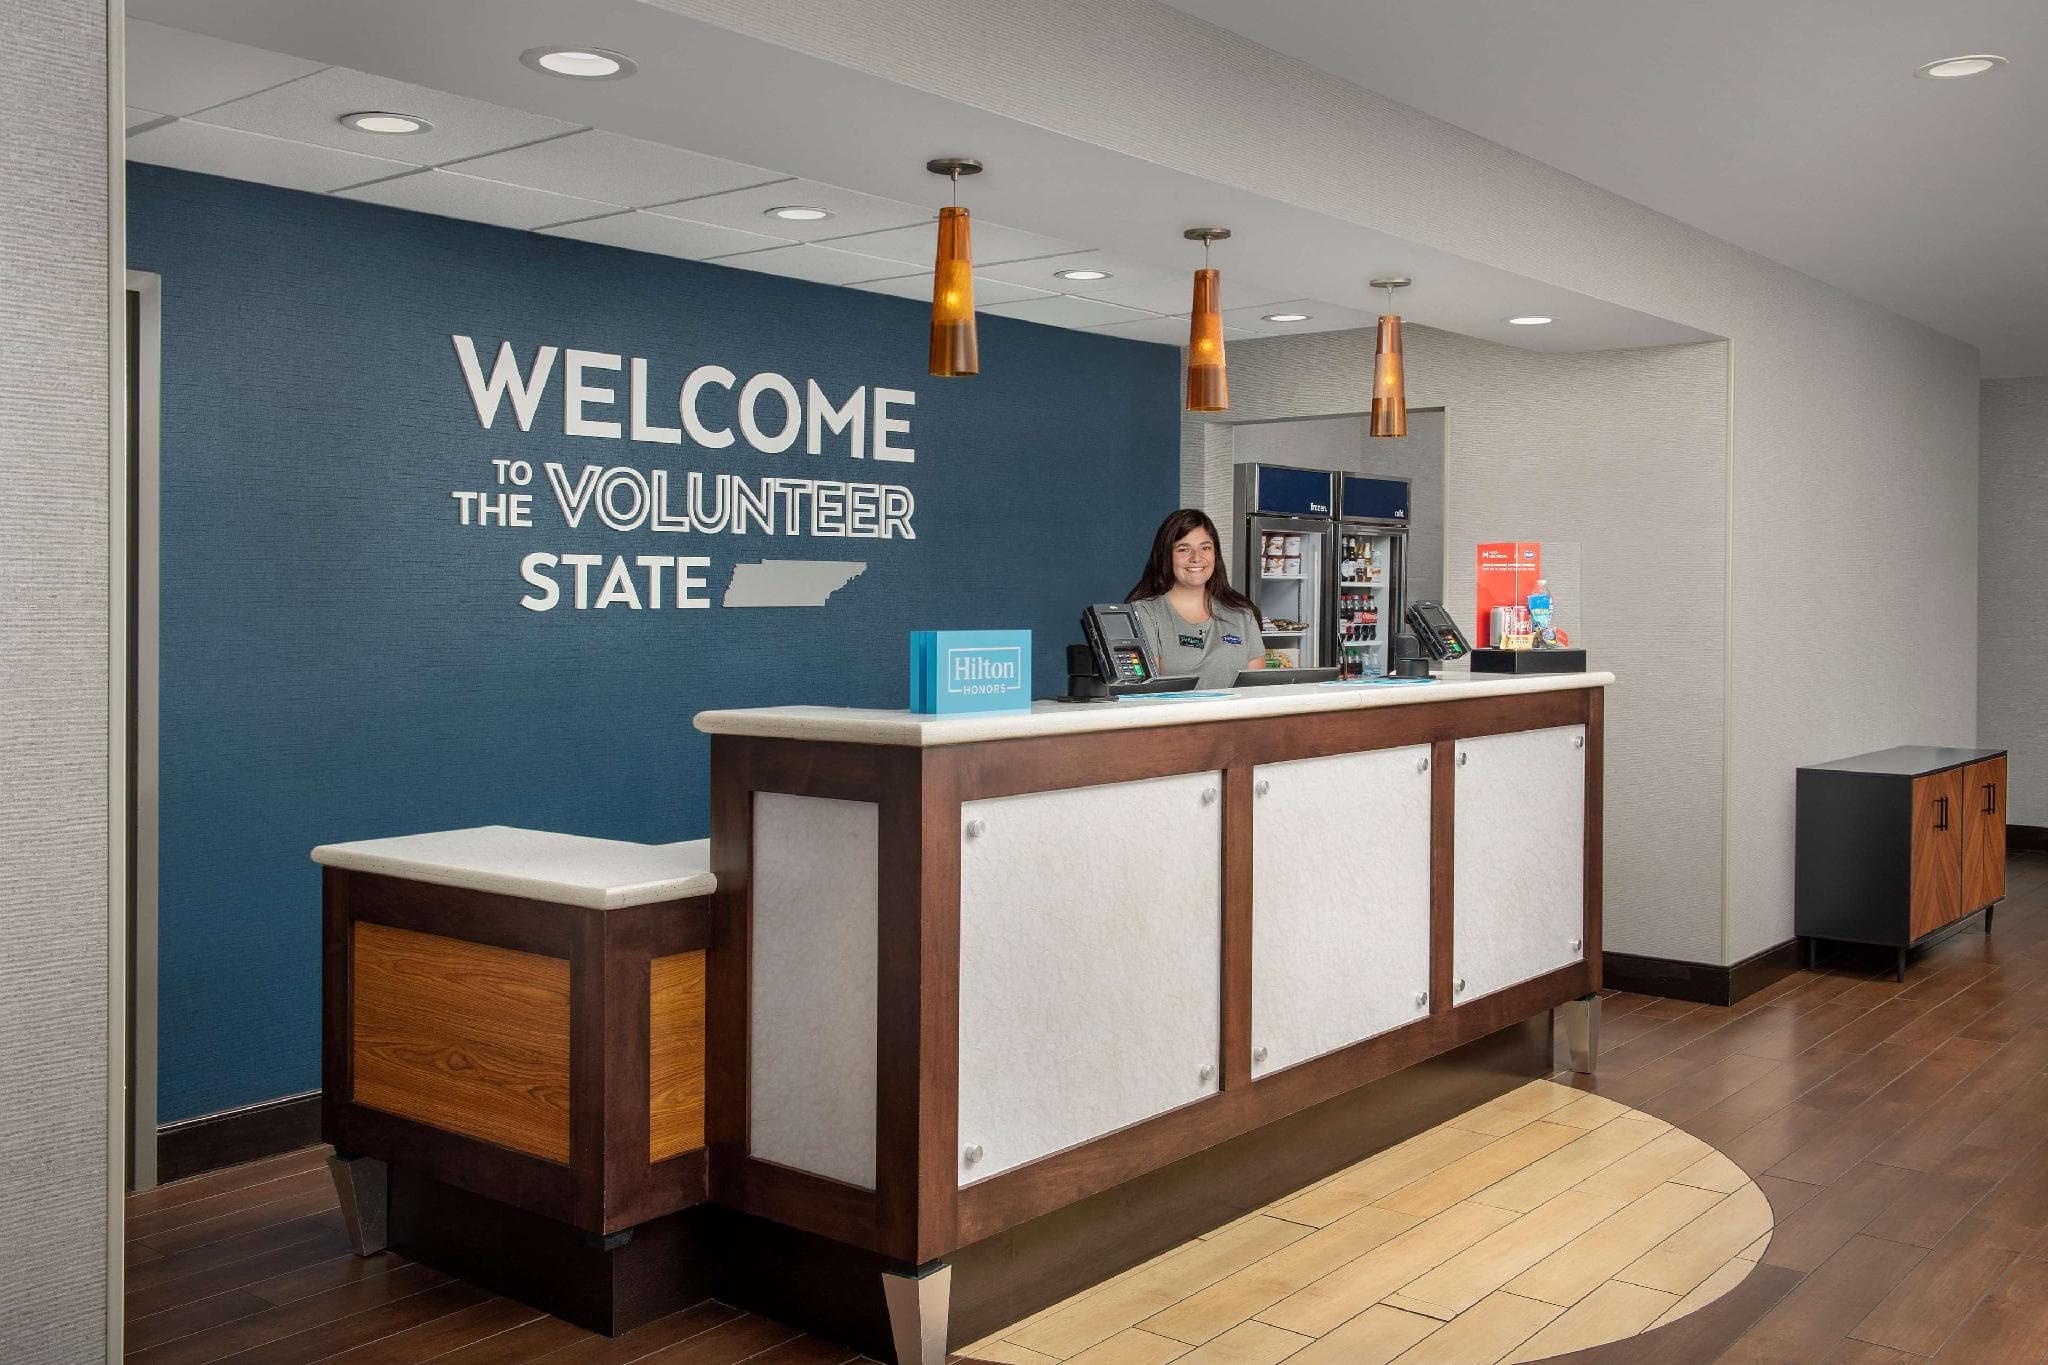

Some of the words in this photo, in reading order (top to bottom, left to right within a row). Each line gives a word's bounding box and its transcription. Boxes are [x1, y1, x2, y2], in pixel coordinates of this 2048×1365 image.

[452, 335, 916, 462] WELCOME
[492, 459, 533, 486] TO
[452, 490, 533, 528] THE
[545, 461, 916, 540] VOLUNTEER
[520, 551, 711, 612] STATE
[954, 656, 1015, 681] Hilton
[963, 683, 1007, 695] HONORS
